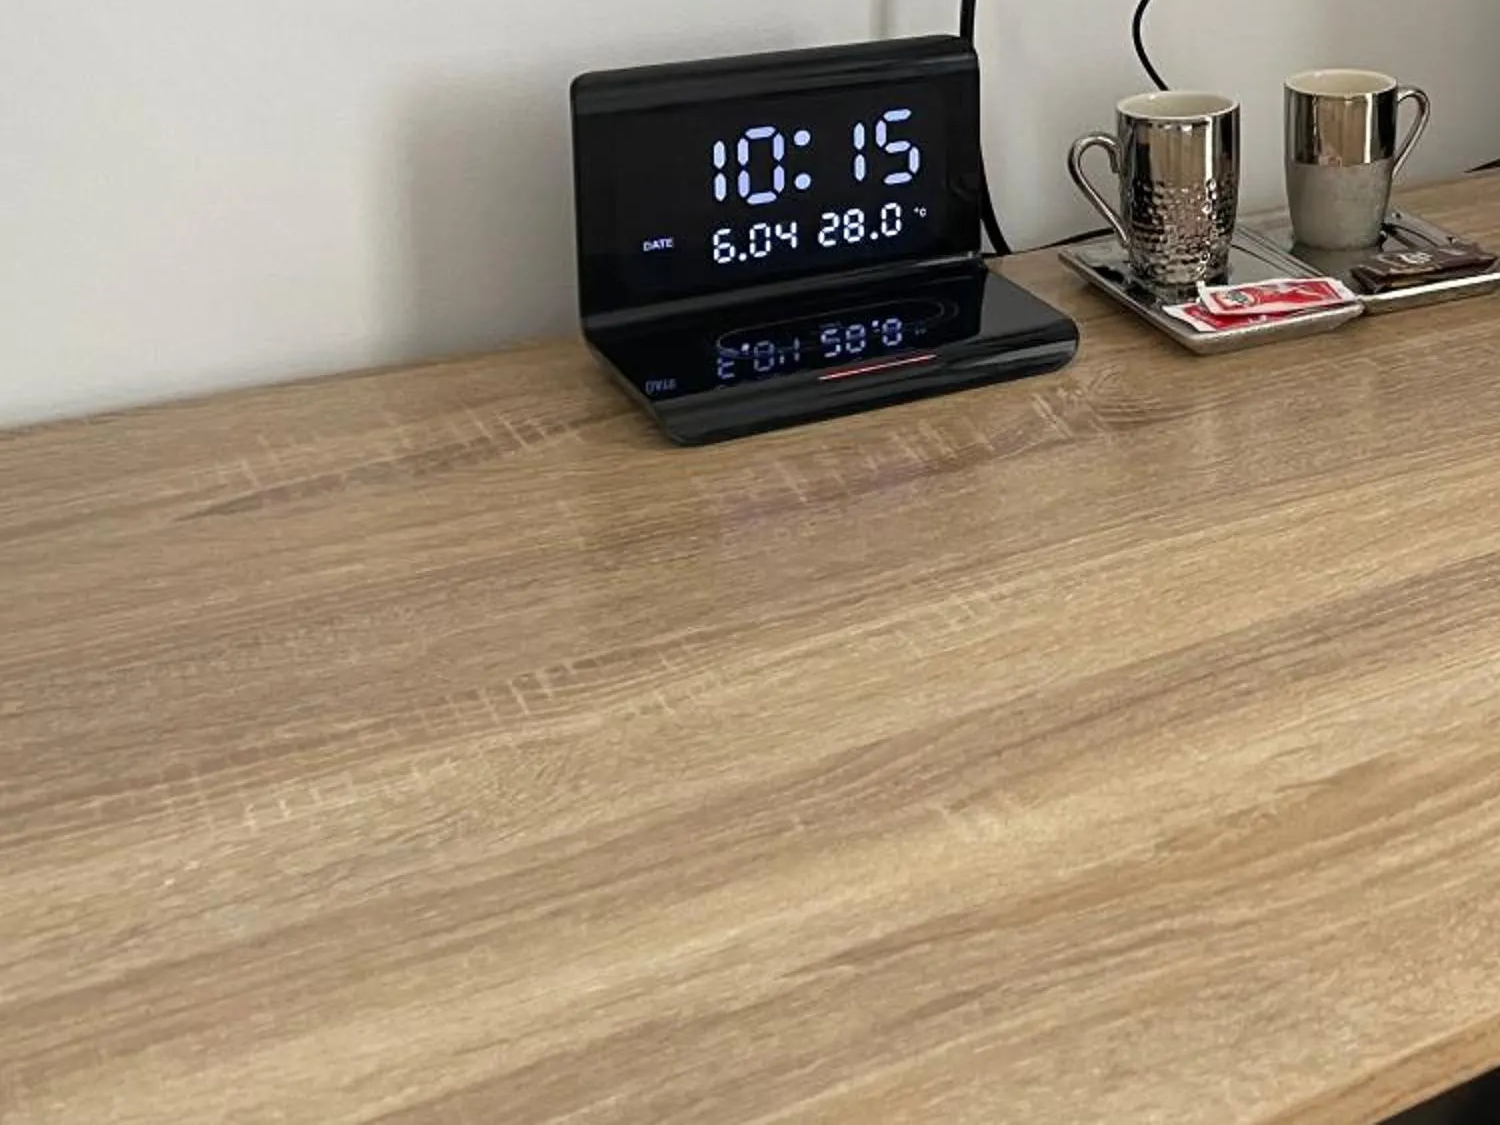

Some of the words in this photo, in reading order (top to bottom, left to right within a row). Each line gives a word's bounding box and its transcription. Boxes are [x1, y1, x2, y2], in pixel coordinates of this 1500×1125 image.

[643, 237, 674, 252] DATE
[713, 221, 798, 264] 6.04
[818, 202, 902, 247] 28.0
